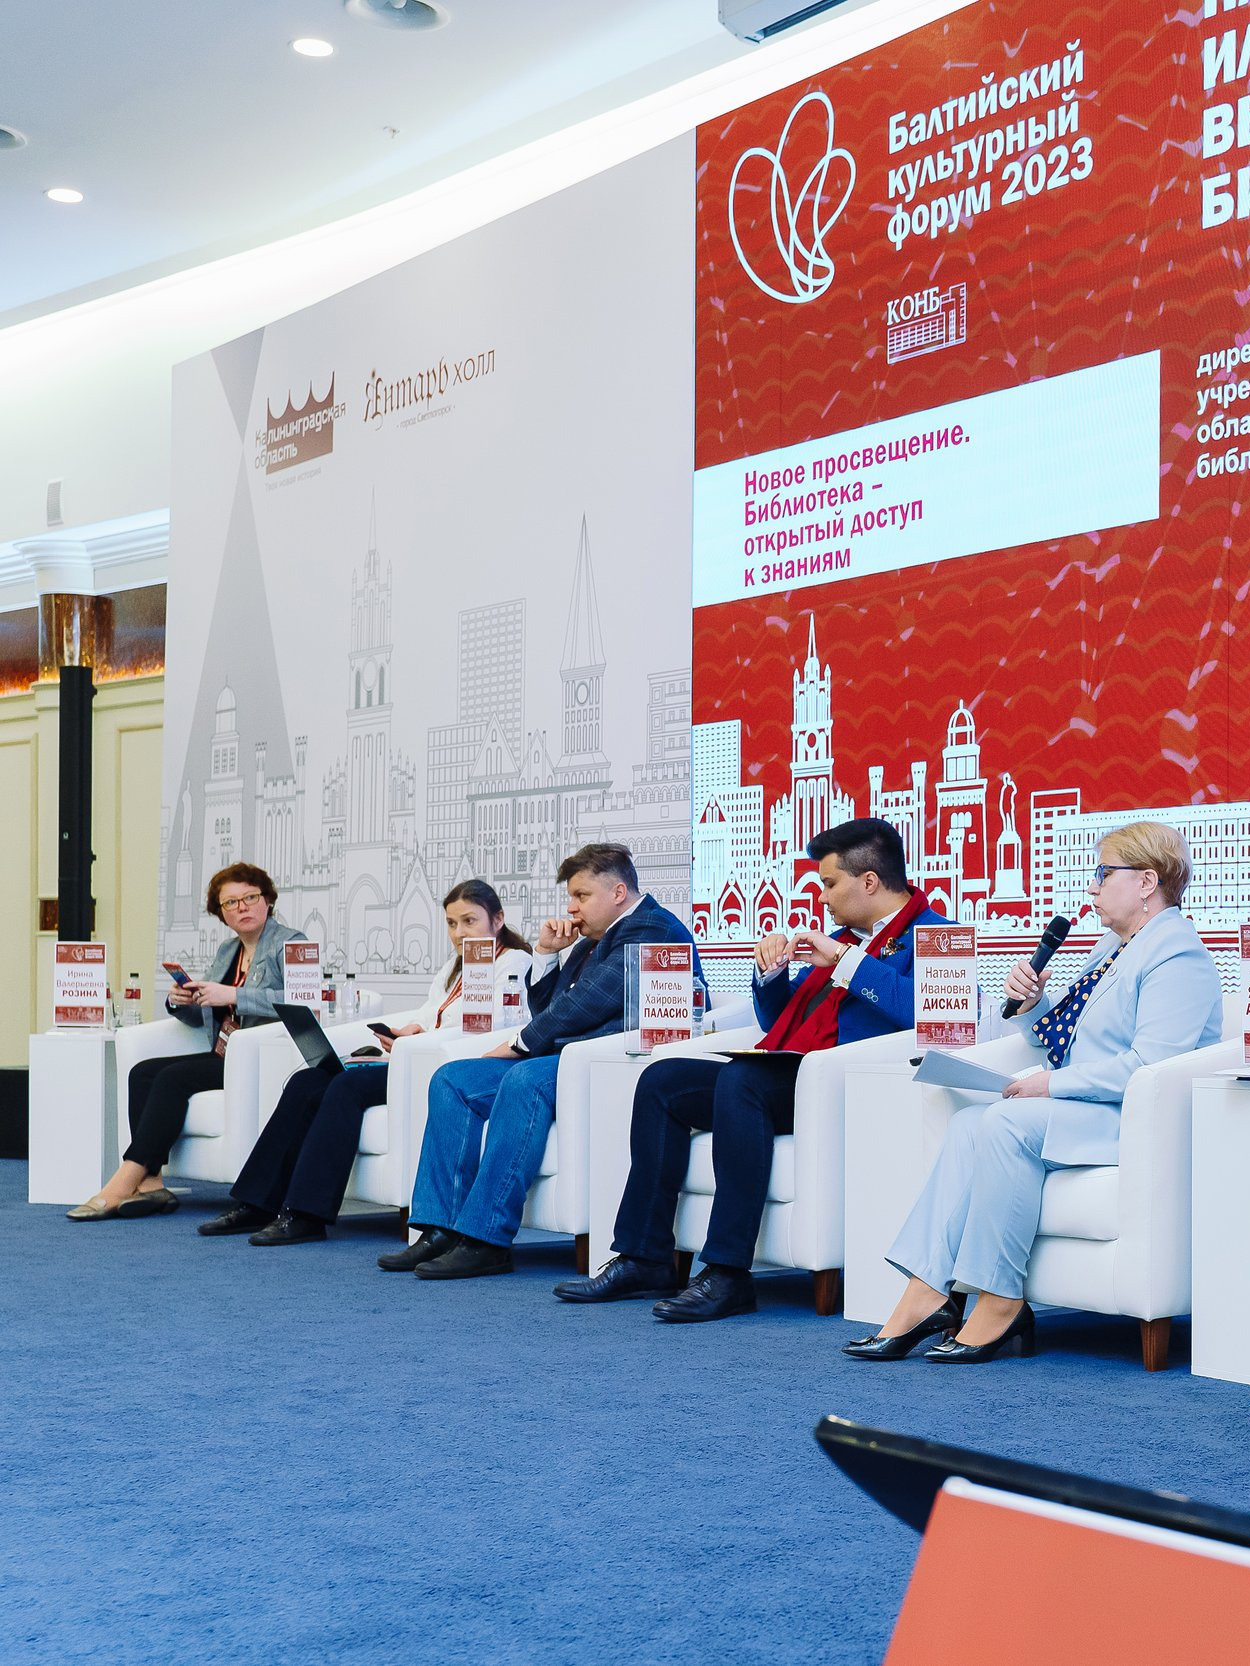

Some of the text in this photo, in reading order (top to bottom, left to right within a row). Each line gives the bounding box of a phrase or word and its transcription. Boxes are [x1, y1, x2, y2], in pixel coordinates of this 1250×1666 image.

[889, 39, 1085, 154] Балтийский
[888, 89, 1079, 203] культурный
[887, 136, 1094, 251] форум 2023
[886, 287, 940, 325] КОНБ
[255, 444, 298, 470] область
[745, 423, 971, 496] Новое просвещение.
[744, 481, 864, 527] Библиотека
[743, 498, 924, 558] открытый доступ
[744, 547, 851, 586] к знаниям
[67, 970, 94, 979] Ирина
[287, 970, 319, 979] Анастасия
[925, 966, 966, 979] Наталья
[56, 980, 105, 989] Валерьевна
[650, 980, 683, 991] Мигель
[920, 982, 972, 994] Ивановна
[62, 990, 98, 998] РОЗИНА
[291, 992, 316, 1001] ГАЧЕВА
[645, 993, 687, 1006] Хайрович
[922, 998, 969, 1012] ДИСКАЯ
[643, 1008, 689, 1019] ПАЛАСИО
